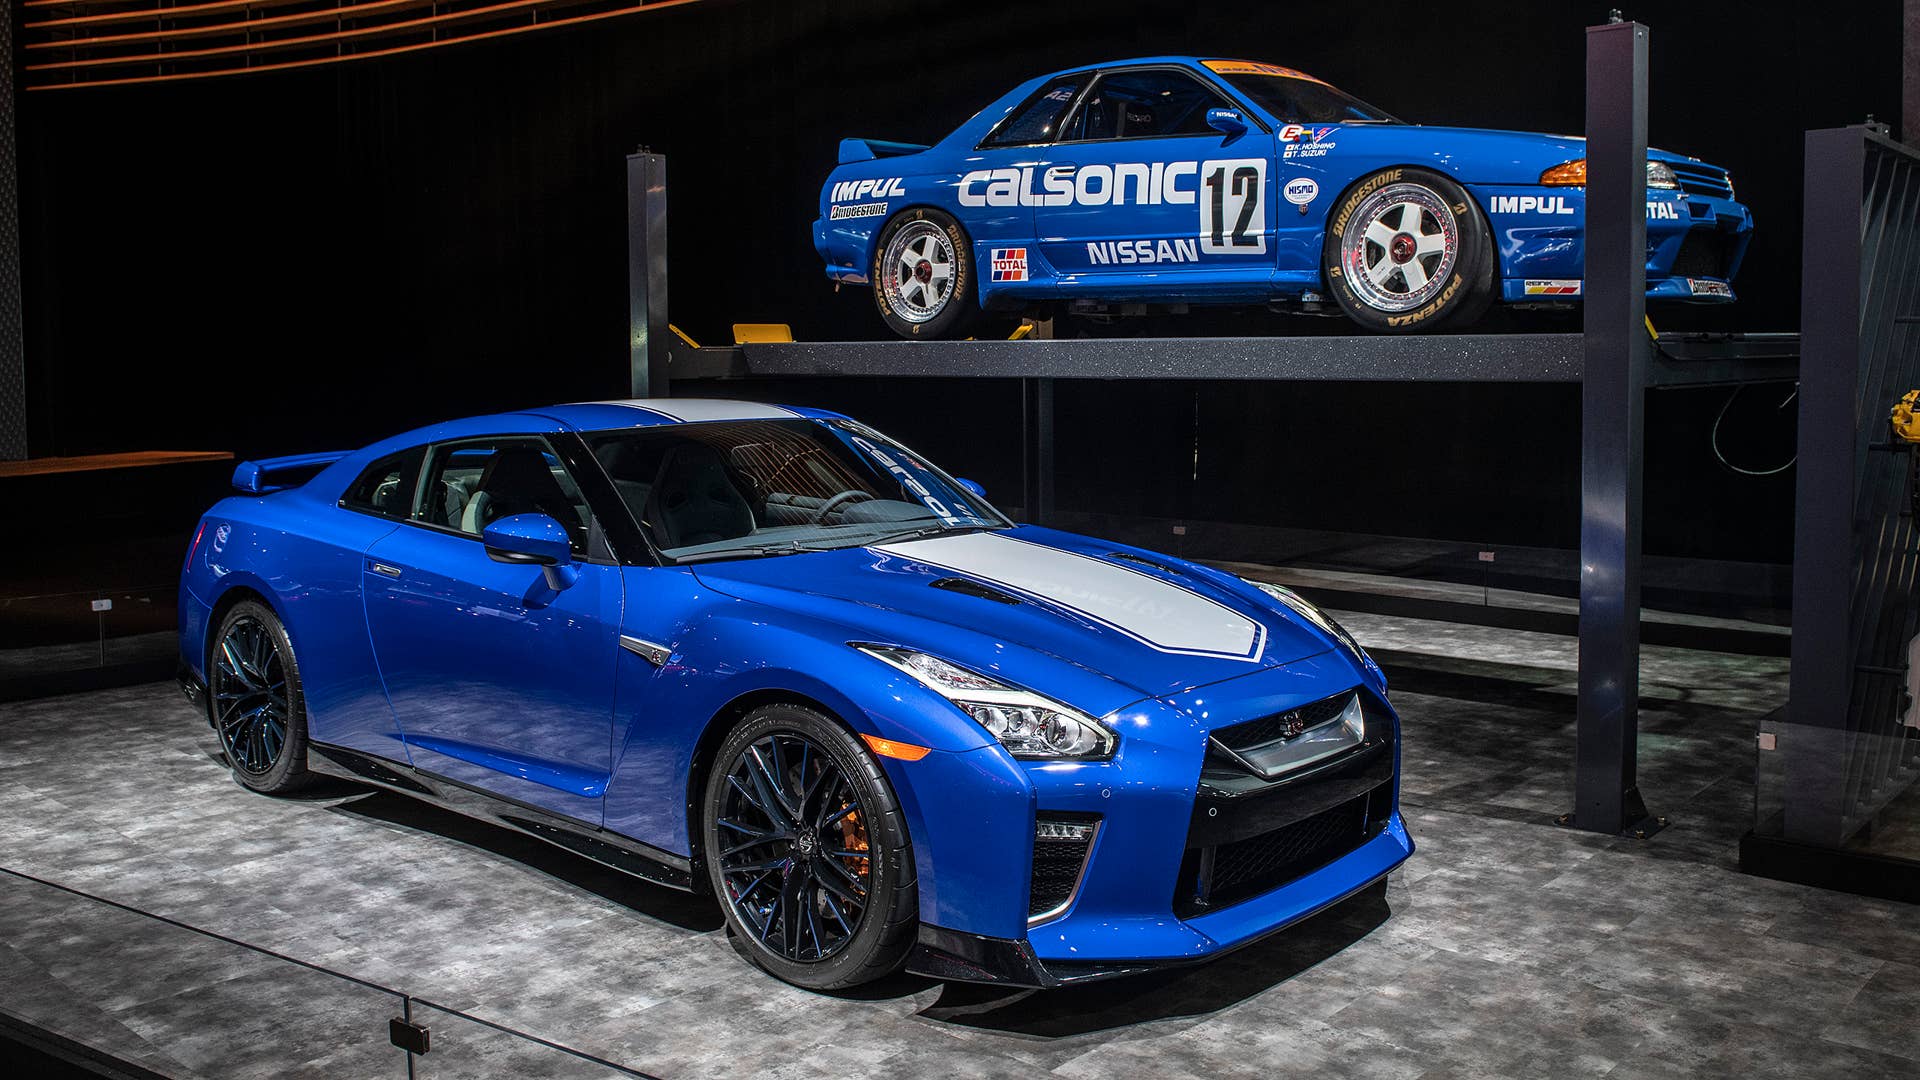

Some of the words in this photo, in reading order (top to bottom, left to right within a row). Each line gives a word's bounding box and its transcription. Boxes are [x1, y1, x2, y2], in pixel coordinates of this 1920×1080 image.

[830, 177, 906, 203] IMPUL
[1288, 185, 1314, 195] NISMO
[831, 203, 887, 219] BRIDGESTONE
[1206, 166, 1259, 247] 12
[1333, 169, 1403, 238] BRIDGESTONE
[1490, 196, 1574, 214] IMPUL
[1646, 202, 1679, 219] TAL
[1087, 239, 1199, 265] NISSAN
[993, 260, 1026, 270] TOTAL
[1387, 273, 1464, 327] POTENZA
